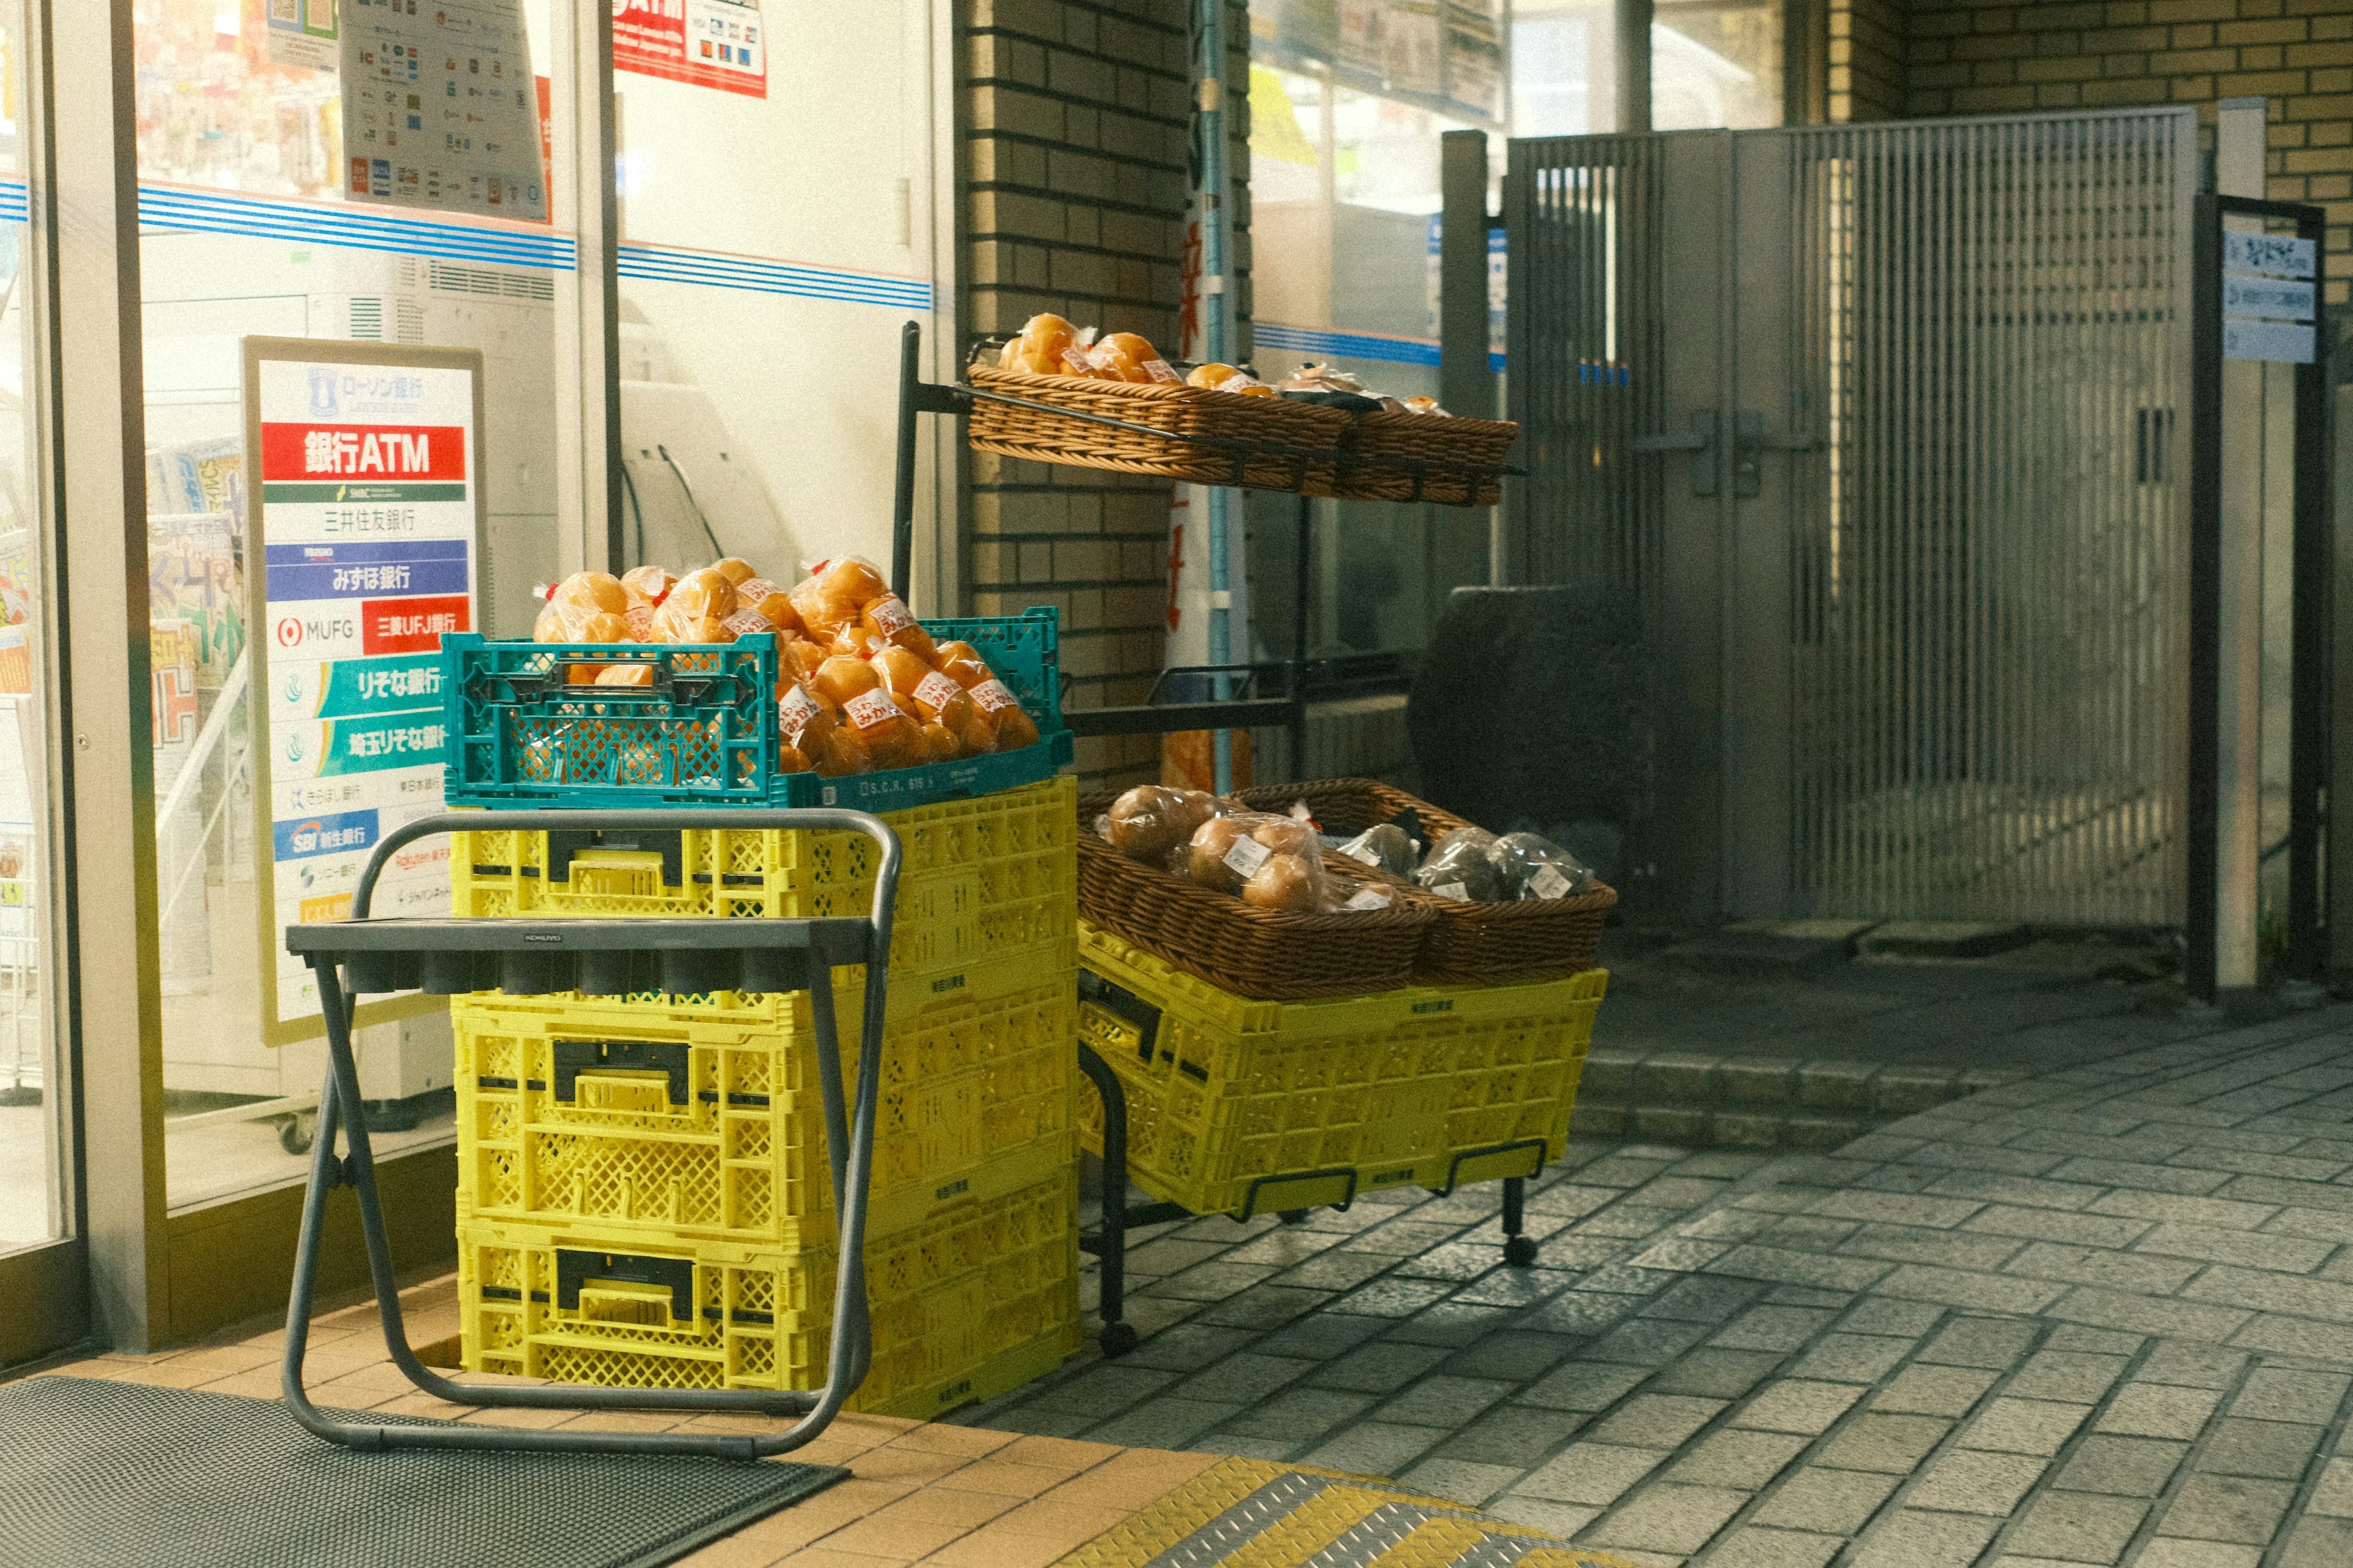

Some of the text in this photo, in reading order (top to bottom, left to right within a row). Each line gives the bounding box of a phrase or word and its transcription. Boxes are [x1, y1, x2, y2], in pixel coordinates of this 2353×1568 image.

[305, 431, 430, 474] 銀行ATM
[325, 509, 415, 532] 三井住友銀行
[333, 565, 411, 591] みずほ銀行
[306, 619, 352, 641] MUFG
[377, 613, 457, 637] 三菱UFJ銀行
[358, 667, 441, 700] りそな銀行
[293, 826, 366, 853] SBI 新生銀行
